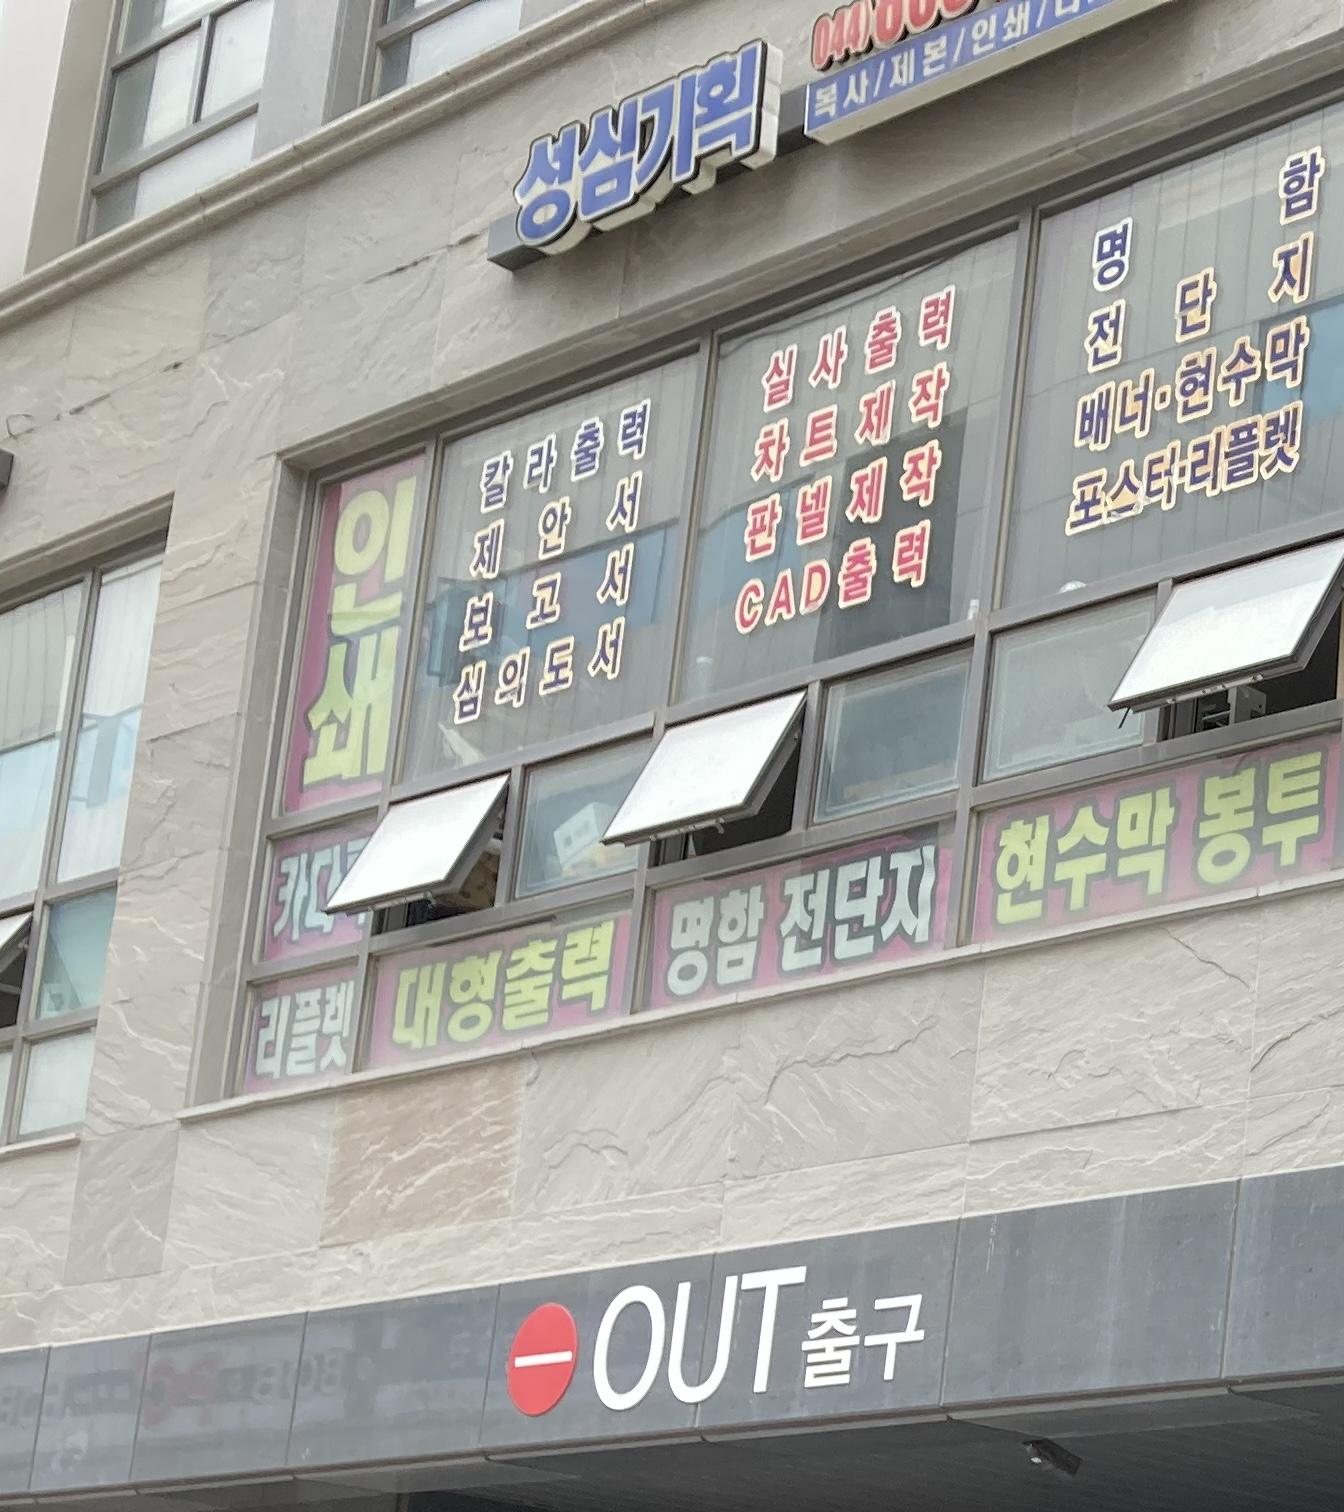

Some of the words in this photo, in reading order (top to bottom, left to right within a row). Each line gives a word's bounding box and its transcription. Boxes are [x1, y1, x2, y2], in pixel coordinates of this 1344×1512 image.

[514, 42, 770, 244] 성심기획
[481, 401, 650, 512] 칼라출력
[752, 361, 949, 483] 차트제작
[745, 441, 942, 563] 판넬제작
[734, 520, 931, 634] CAD출력
[452, 620, 624, 725] 심의도서
[995, 787, 1174, 926] 현수막
[1196, 750, 1323, 885] 봉투
[667, 882, 764, 996] 명함
[778, 844, 936, 973] 전단지
[256, 980, 354, 1079] 리플렛
[391, 919, 614, 1050] 대형출력
[593, 1266, 807, 1412] OUT
[801, 1294, 925, 1388] 출구
